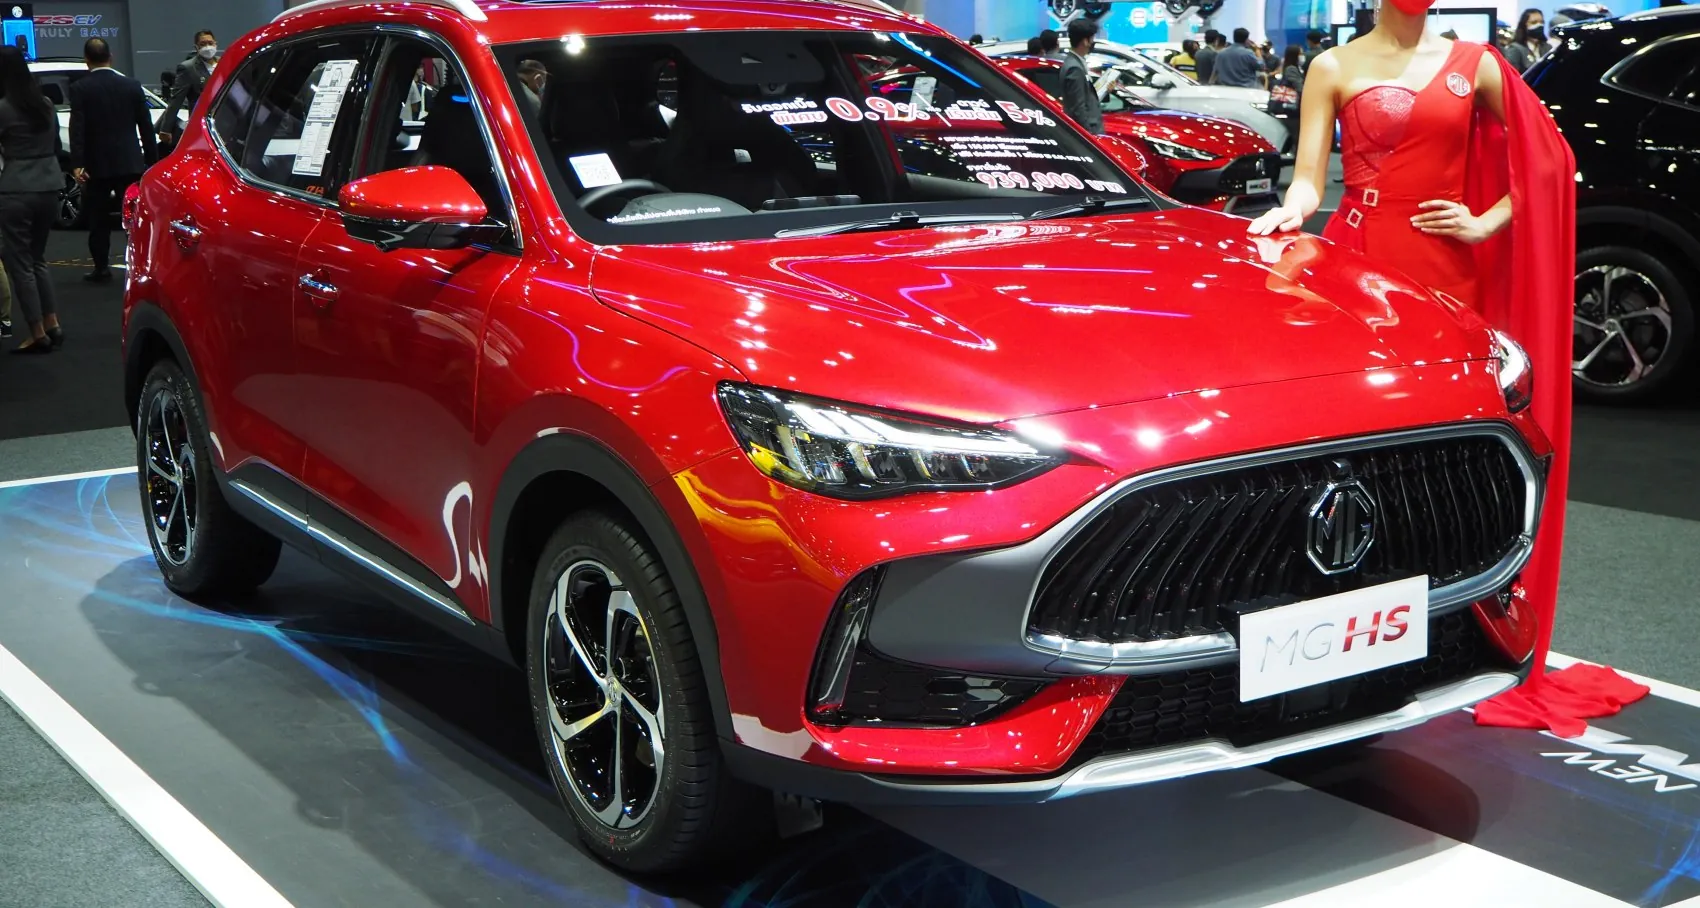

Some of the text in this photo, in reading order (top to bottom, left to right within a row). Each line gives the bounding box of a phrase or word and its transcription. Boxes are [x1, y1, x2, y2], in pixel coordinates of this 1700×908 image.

[80, 28, 119, 37] EASY
[826, 96, 931, 122] 0.9%
[995, 100, 1056, 127] 5%
[976, 172, 1084, 191] 939,000
[1315, 490, 1372, 566] MG
[1261, 605, 1411, 673] MG HS
[1539, 752, 1698, 793] NEW
